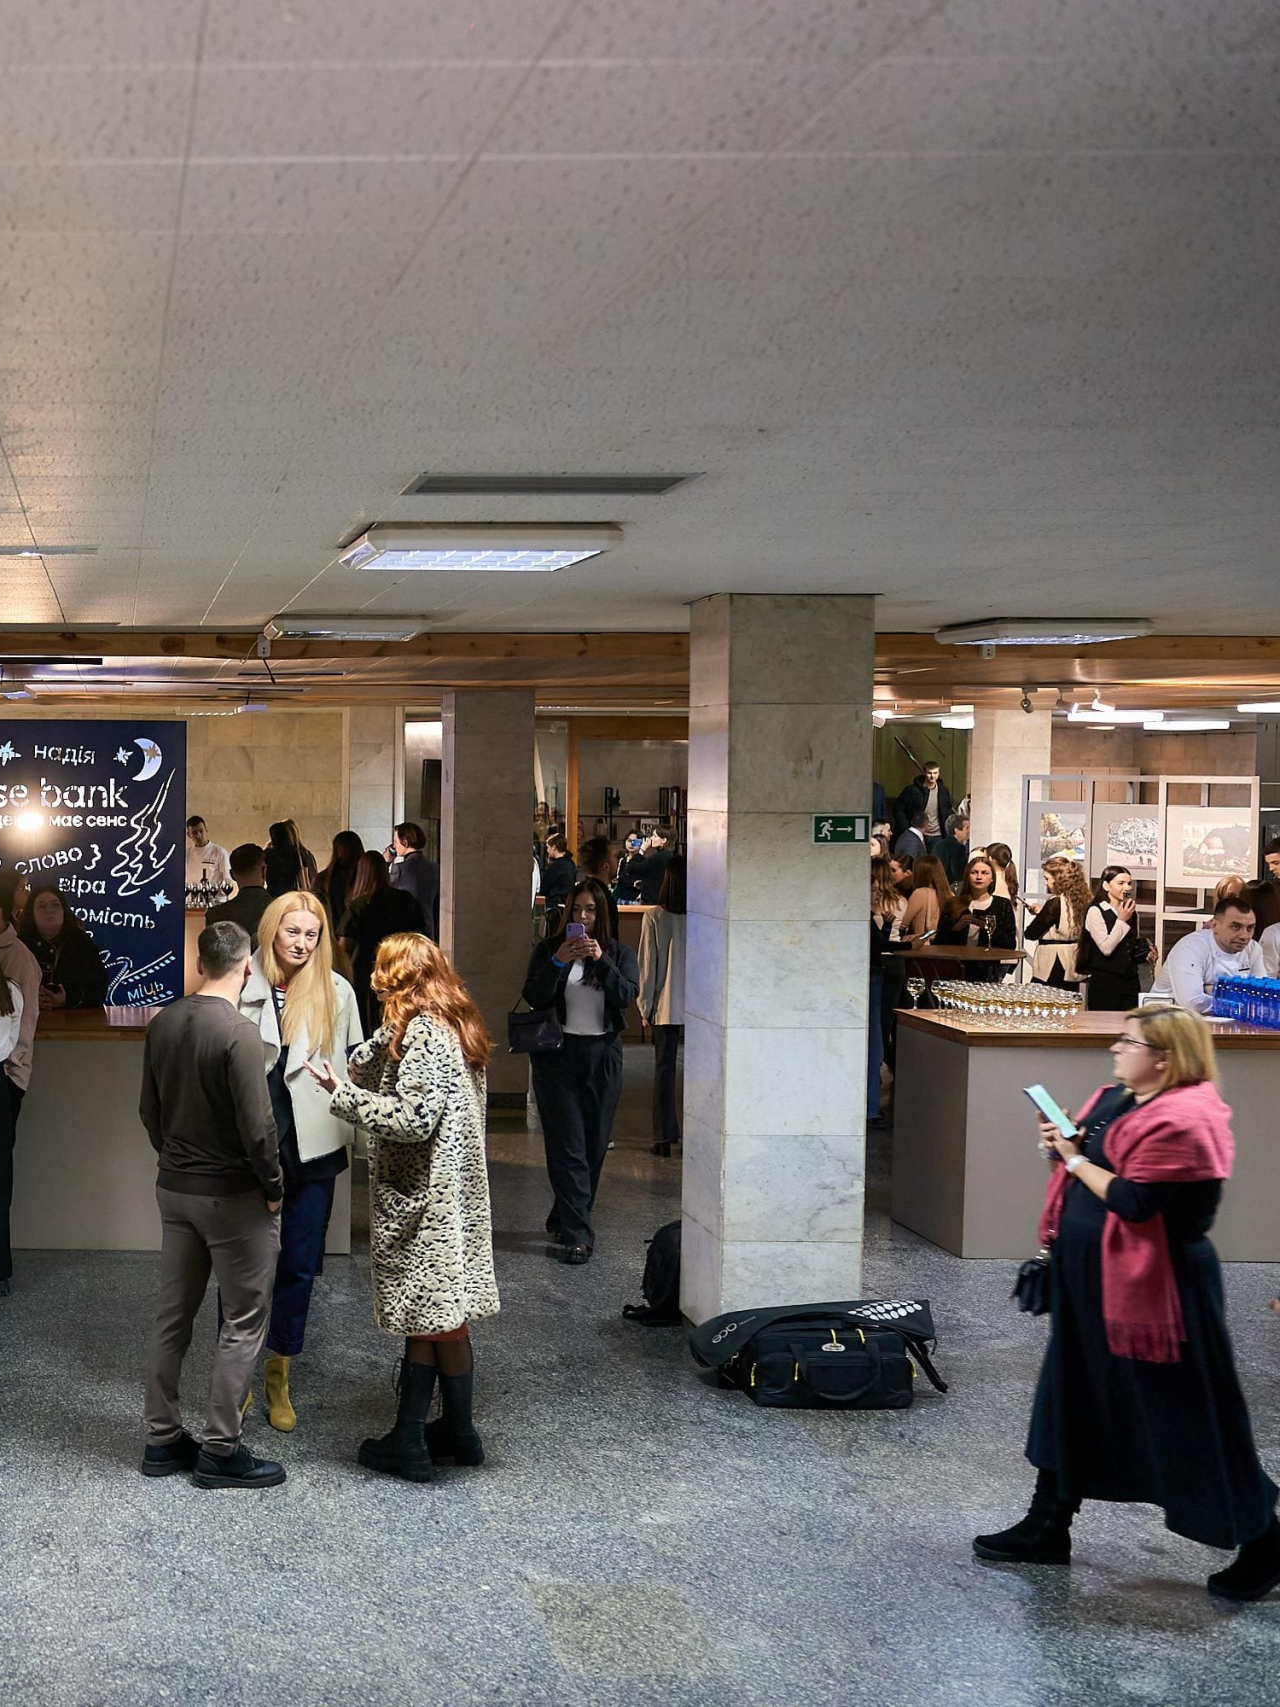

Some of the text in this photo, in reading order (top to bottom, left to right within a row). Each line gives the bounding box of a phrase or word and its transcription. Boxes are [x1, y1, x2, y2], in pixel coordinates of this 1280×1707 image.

[34, 744, 95, 766] надія
[40, 777, 129, 808] bank
[49, 814, 83, 828] має
[86, 815, 128, 828] сенс
[15, 846, 83, 875] слово
[59, 874, 106, 898] віра
[70, 906, 156, 929] омість
[127, 981, 164, 1002] міць
